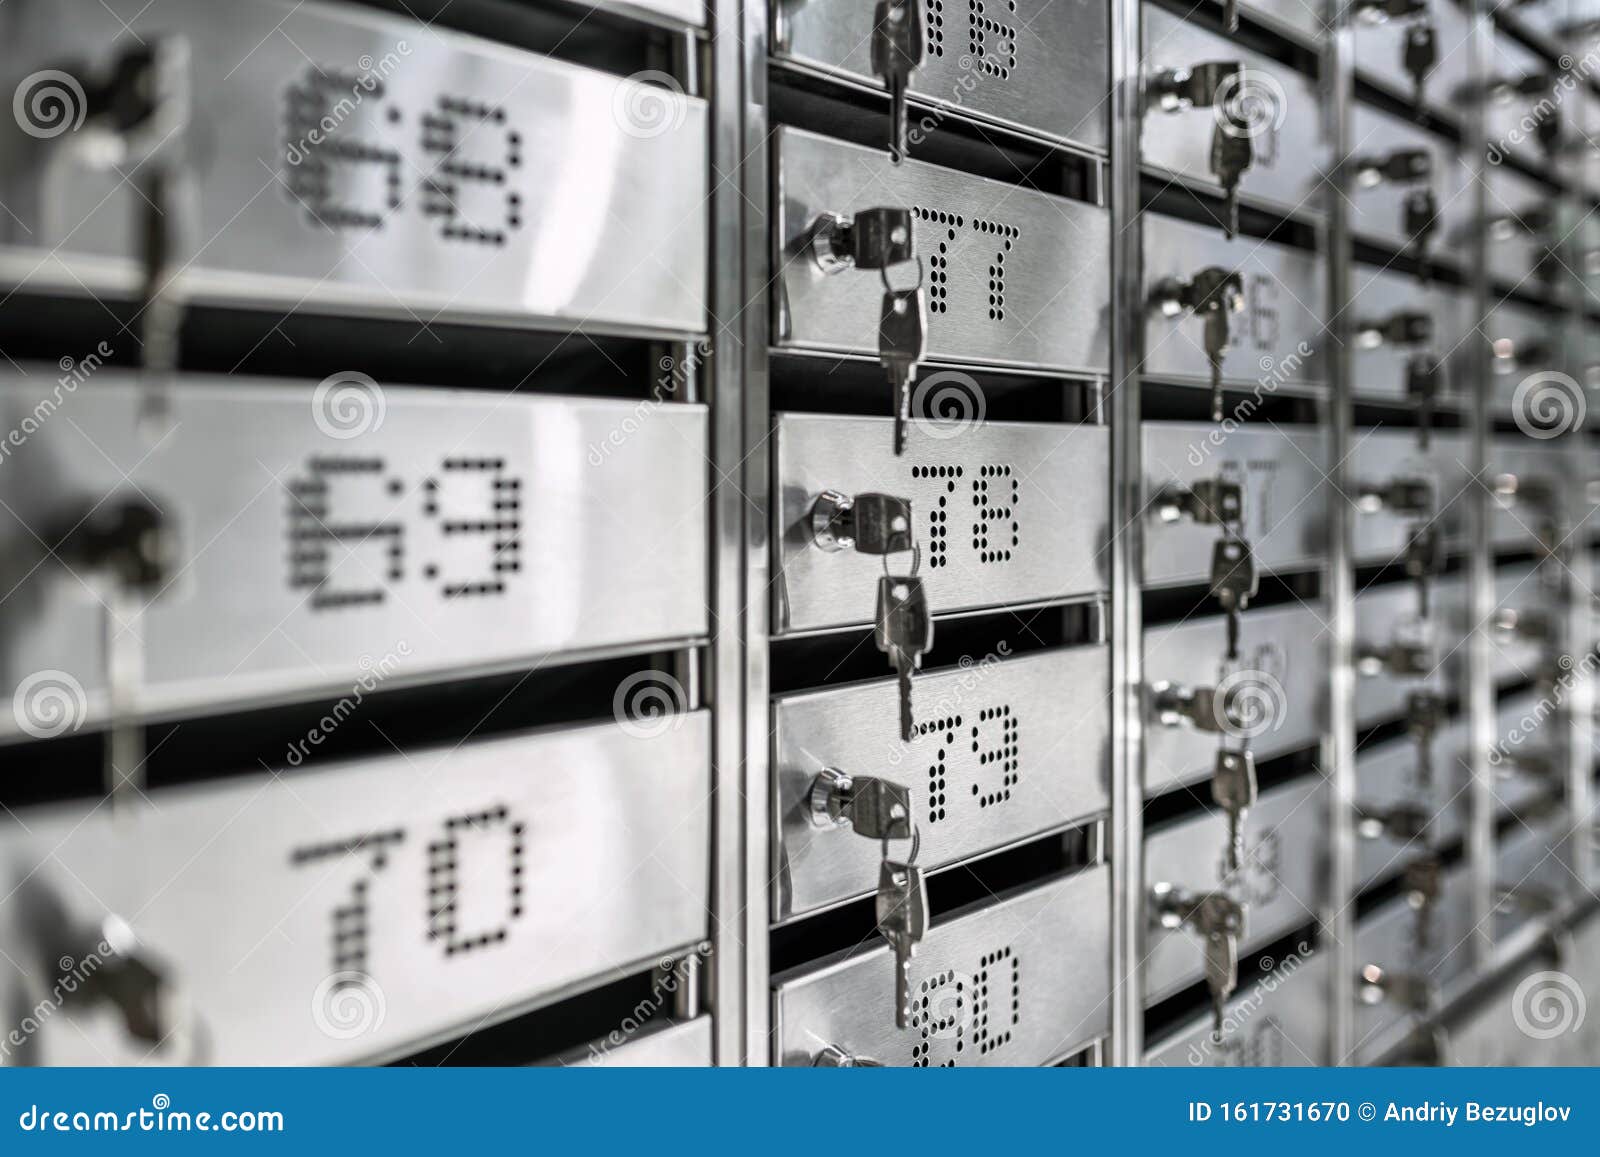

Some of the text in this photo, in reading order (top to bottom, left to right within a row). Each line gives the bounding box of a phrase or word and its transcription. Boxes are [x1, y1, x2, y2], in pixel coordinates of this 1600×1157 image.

[284, 66, 522, 246] 68
[911, 205, 1020, 322] 77
[286, 456, 522, 610] 69
[911, 464, 1019, 569] 78
[907, 704, 1018, 824] 79
[289, 804, 524, 990] 70
[912, 946, 1019, 1067] 80
